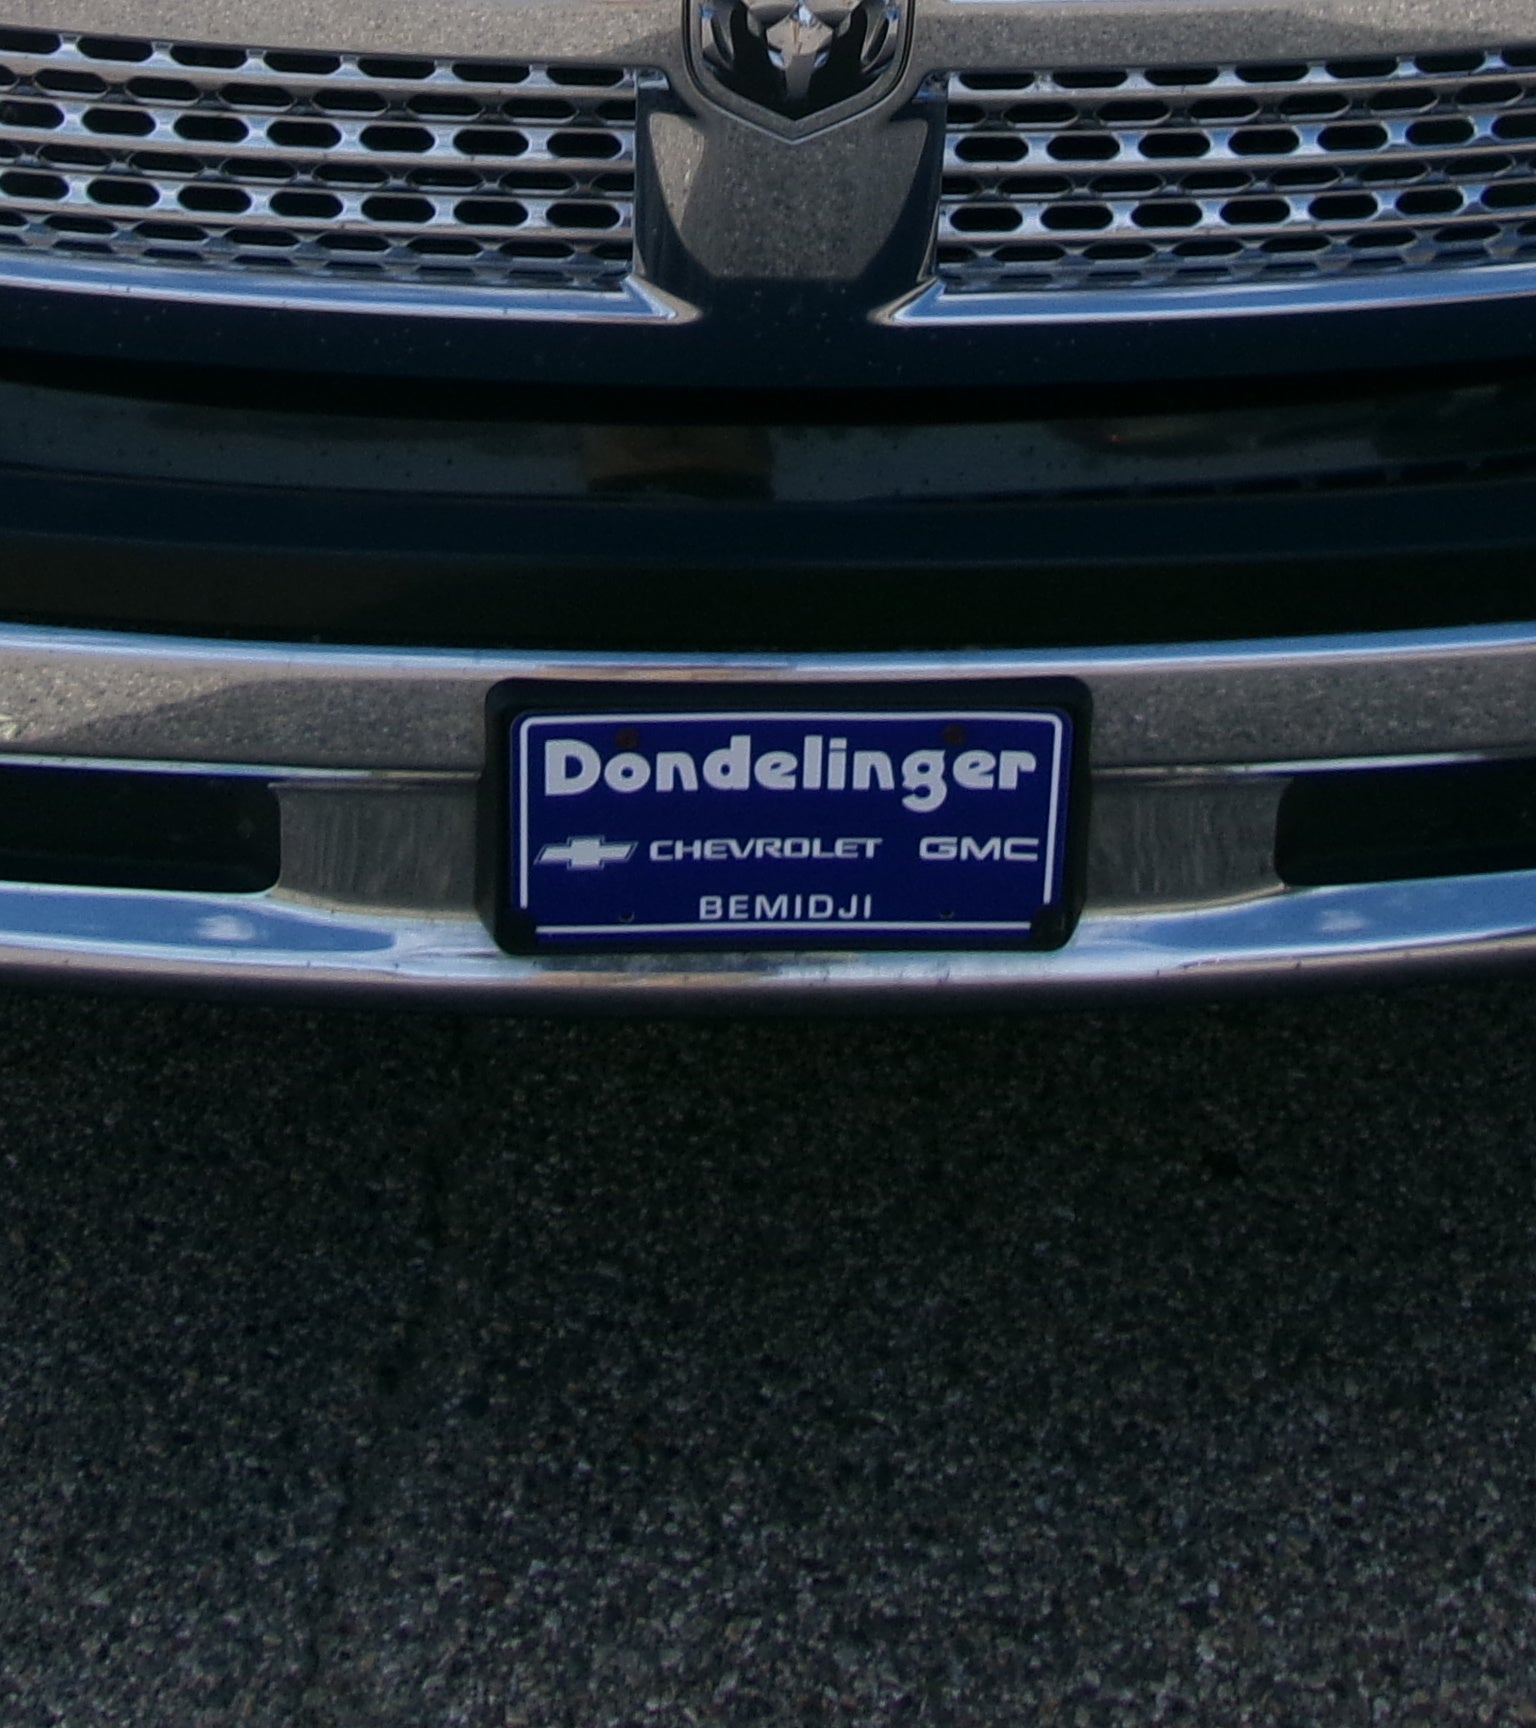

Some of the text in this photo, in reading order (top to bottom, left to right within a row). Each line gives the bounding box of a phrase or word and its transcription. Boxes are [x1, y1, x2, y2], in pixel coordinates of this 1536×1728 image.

[544, 734, 1038, 813] Dondelinger
[648, 836, 1040, 862] CHEVROLET GMC
[698, 894, 873, 921] BEMIDJI
